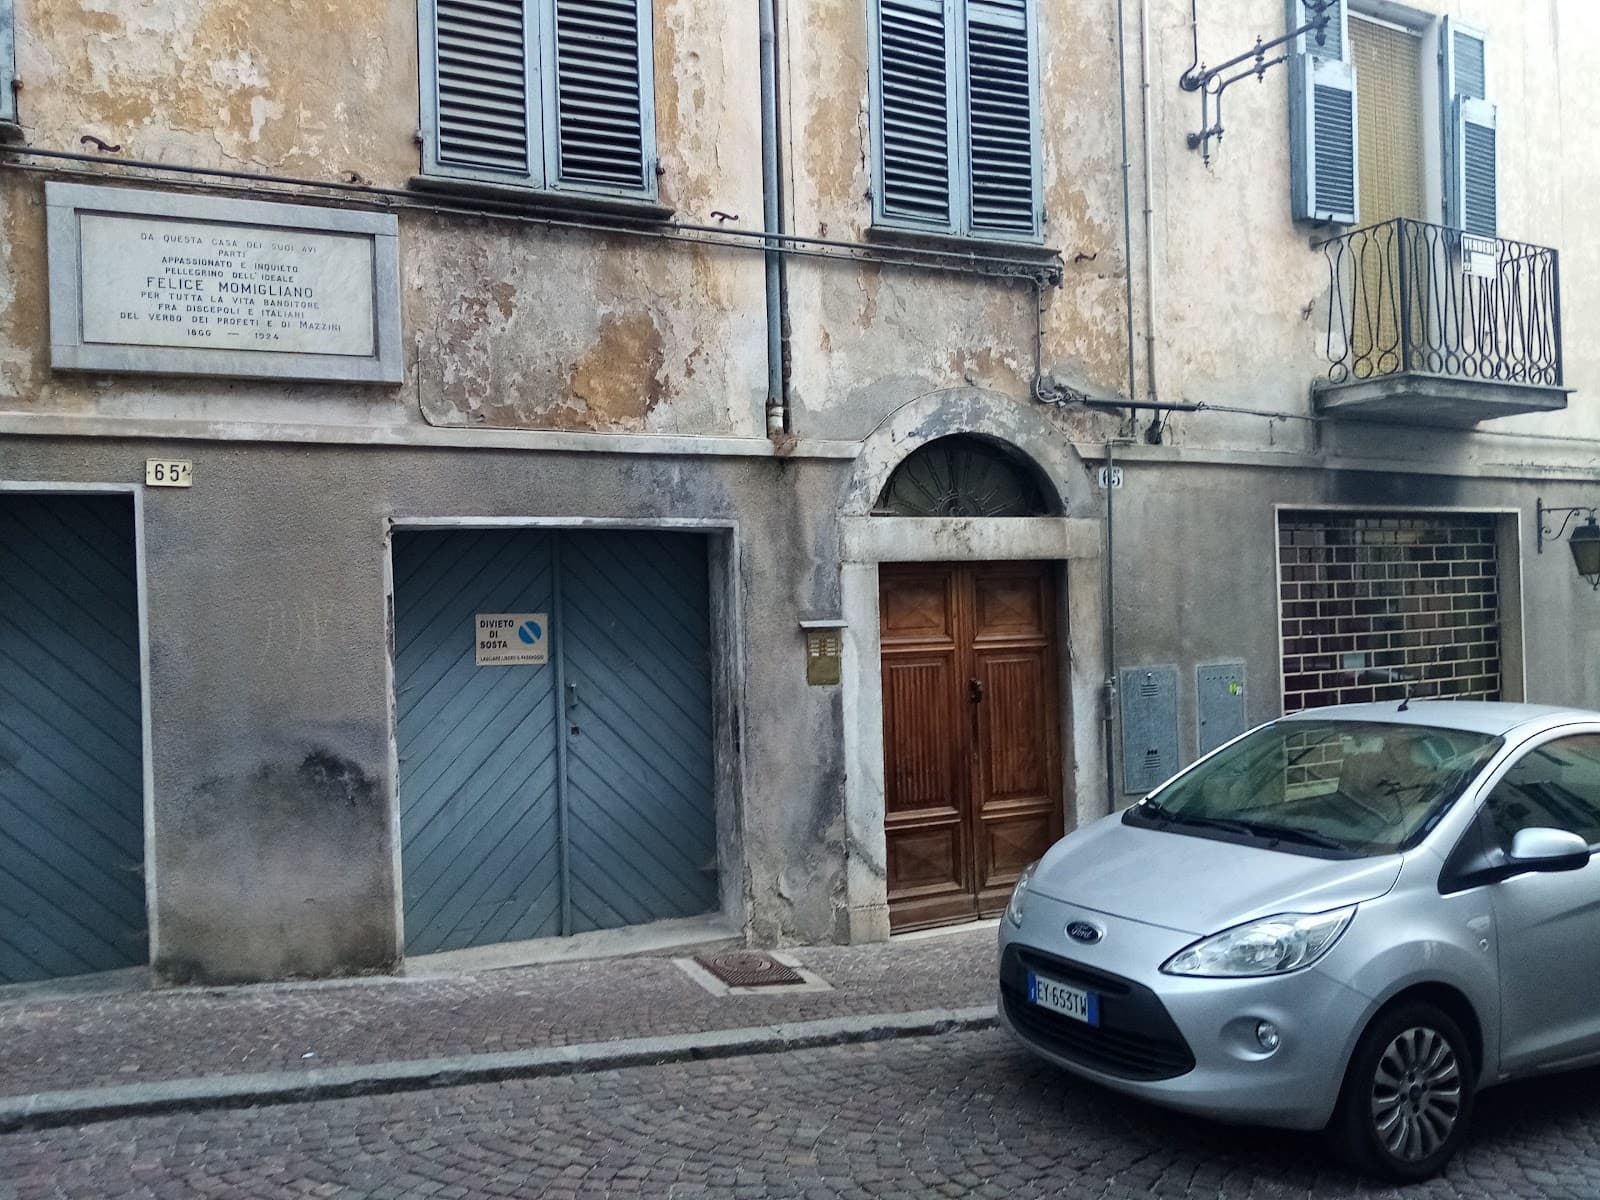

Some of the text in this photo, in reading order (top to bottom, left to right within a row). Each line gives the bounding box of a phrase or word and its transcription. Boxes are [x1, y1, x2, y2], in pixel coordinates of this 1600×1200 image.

[140, 232, 317, 254] DA QUESTA CASA DEI SUOI AVI
[161, 256, 298, 273] APPASSIONATO E INQUIETO
[165, 267, 224, 278] PELLEGRINO
[146, 276, 313, 298] FELICE MOMIGLIANO
[140, 291, 320, 310] PER TUTTA LA VITA BANDITORE
[158, 303, 304, 319] FRA DISCEPOLI E ITALIANI
[119, 311, 140, 320] DEL
[148, 313, 182, 322] VERBO
[191, 315, 208, 324] DEI
[217, 317, 259, 327] PROFETI
[267, 320, 273, 328] E
[281, 321, 290, 329] DI
[255, 332, 280, 340] 1924
[480, 619, 514, 629] DIVIETO
[489, 630, 498, 639] DI
[480, 640, 508, 649] SOSTA
[1071, 925, 1093, 937] Ford
